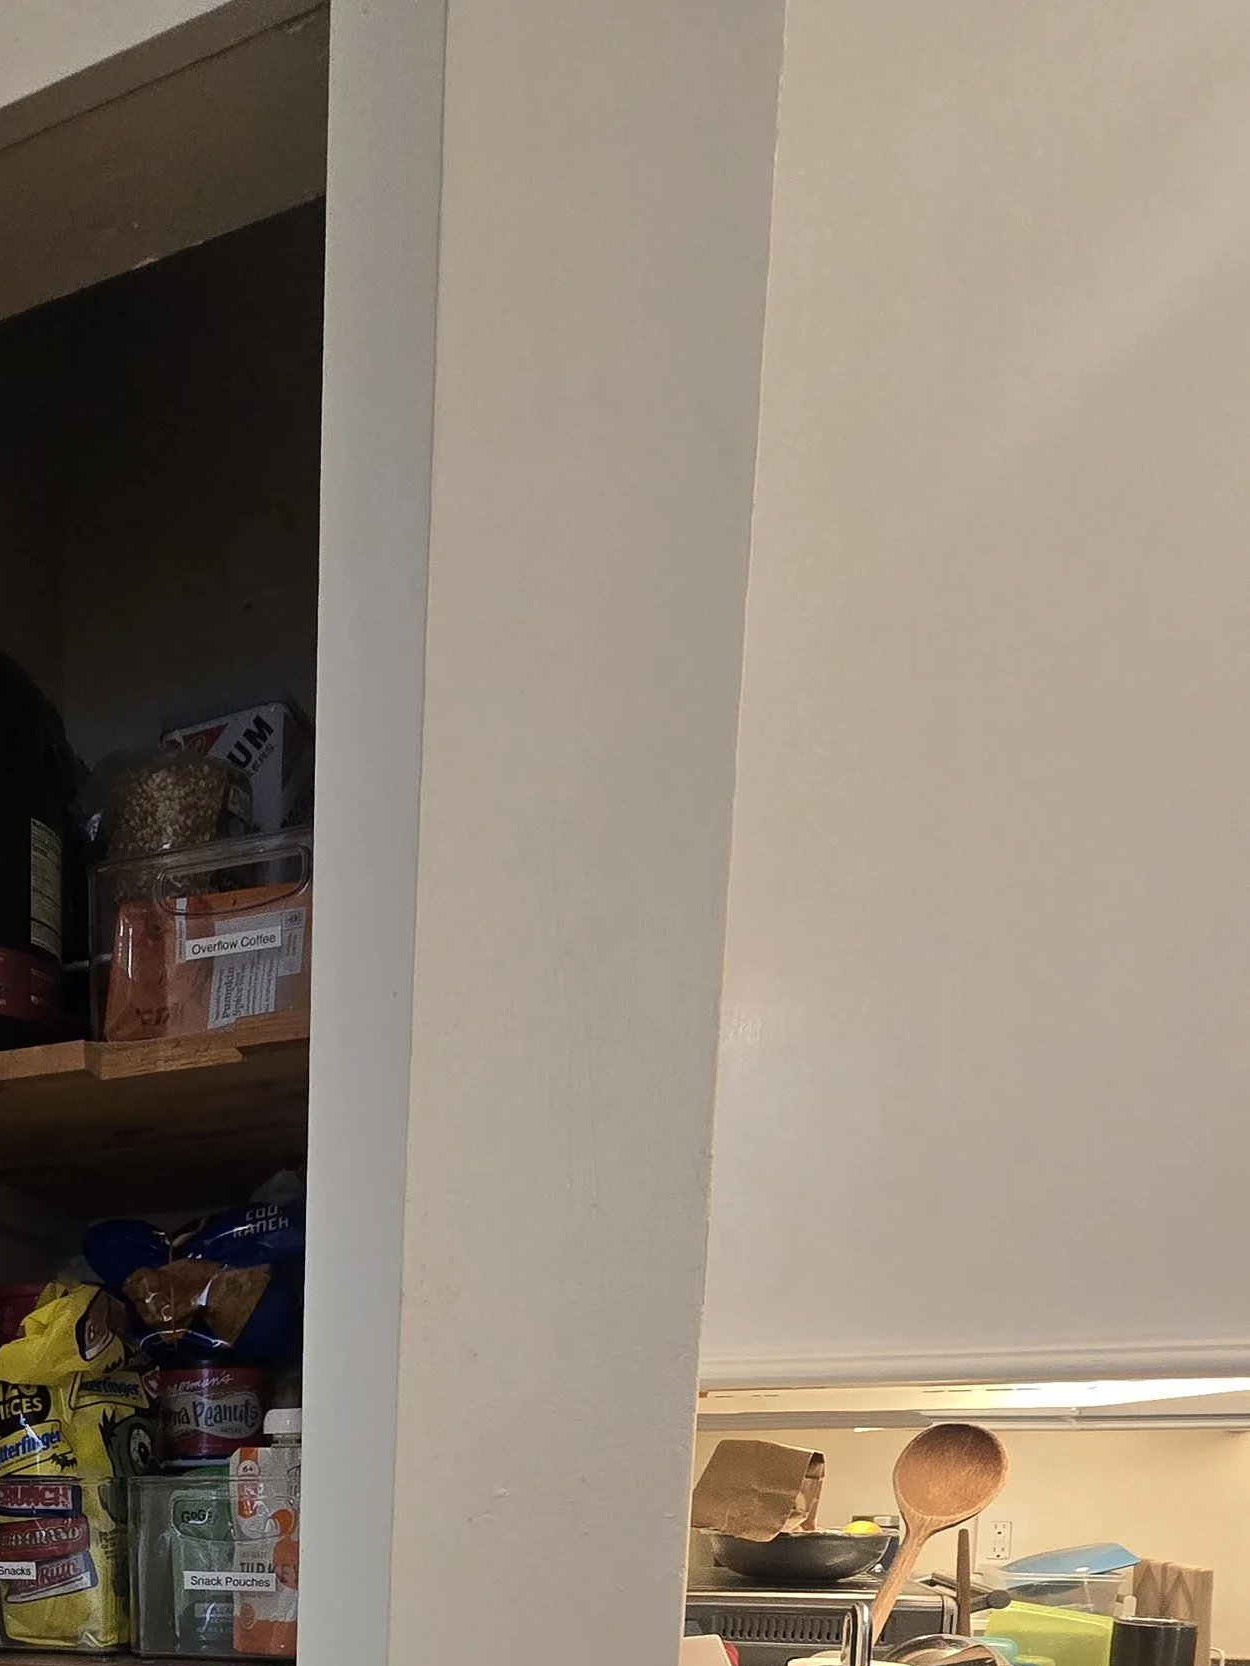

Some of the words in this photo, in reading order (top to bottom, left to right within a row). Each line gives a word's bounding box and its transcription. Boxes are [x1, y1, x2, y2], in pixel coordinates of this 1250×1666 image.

[191, 939, 239, 955] Overflow
[240, 932, 276, 948] Coffee
[221, 967, 235, 1019] Pumpkin
[233, 1216, 289, 1240] RANCH
[192, 1399, 259, 1428] Peanuts
[190, 1575, 223, 1587] Snack
[224, 1577, 271, 1588] Pouches
